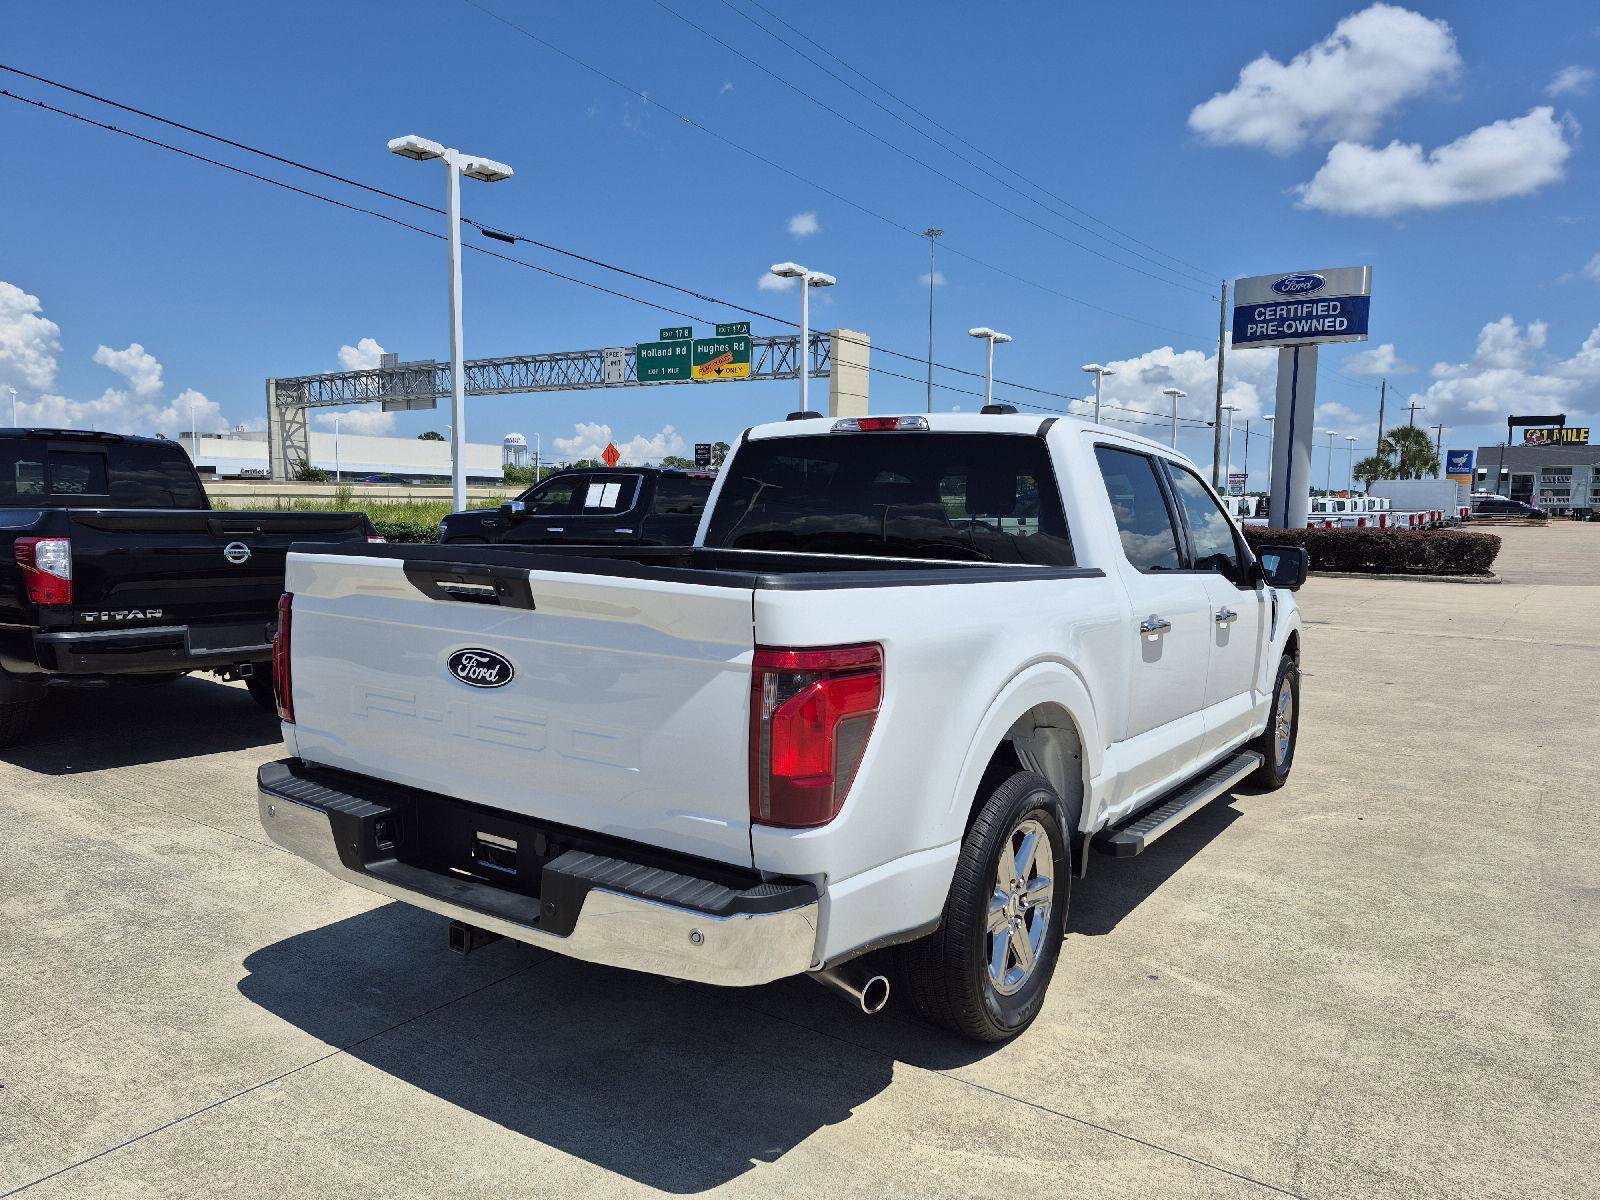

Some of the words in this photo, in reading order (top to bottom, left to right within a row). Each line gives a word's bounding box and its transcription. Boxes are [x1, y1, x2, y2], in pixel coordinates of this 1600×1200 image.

[1281, 277, 1313, 292] Ford
[1254, 301, 1341, 321] CERTIFIED
[1246, 317, 1348, 337] PRE-OWNED
[641, 347, 672, 358] Holland
[676, 345, 687, 355] Rd
[697, 343, 730, 355] Hughes
[733, 341, 745, 351] Rd
[661, 367, 665, 375] 1
[725, 366, 743, 374] ONLY
[1553, 428, 1589, 442] MILE
[80, 608, 163, 622] TITAN
[458, 652, 500, 683] Ford
